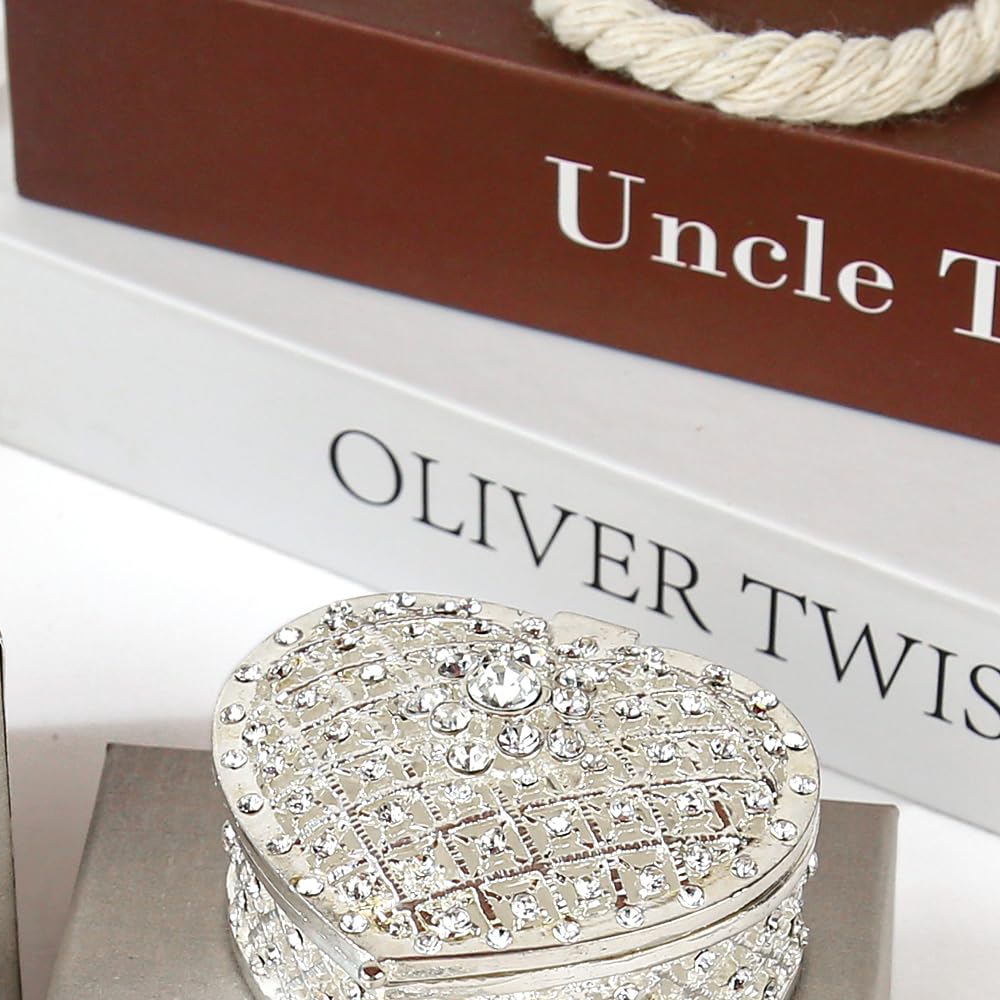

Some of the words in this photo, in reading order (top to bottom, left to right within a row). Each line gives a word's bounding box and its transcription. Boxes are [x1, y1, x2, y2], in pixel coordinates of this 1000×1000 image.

[544, 154, 894, 315] Uncle
[328, 428, 712, 634] OLIVER
[740, 573, 1000, 741] TWIS
